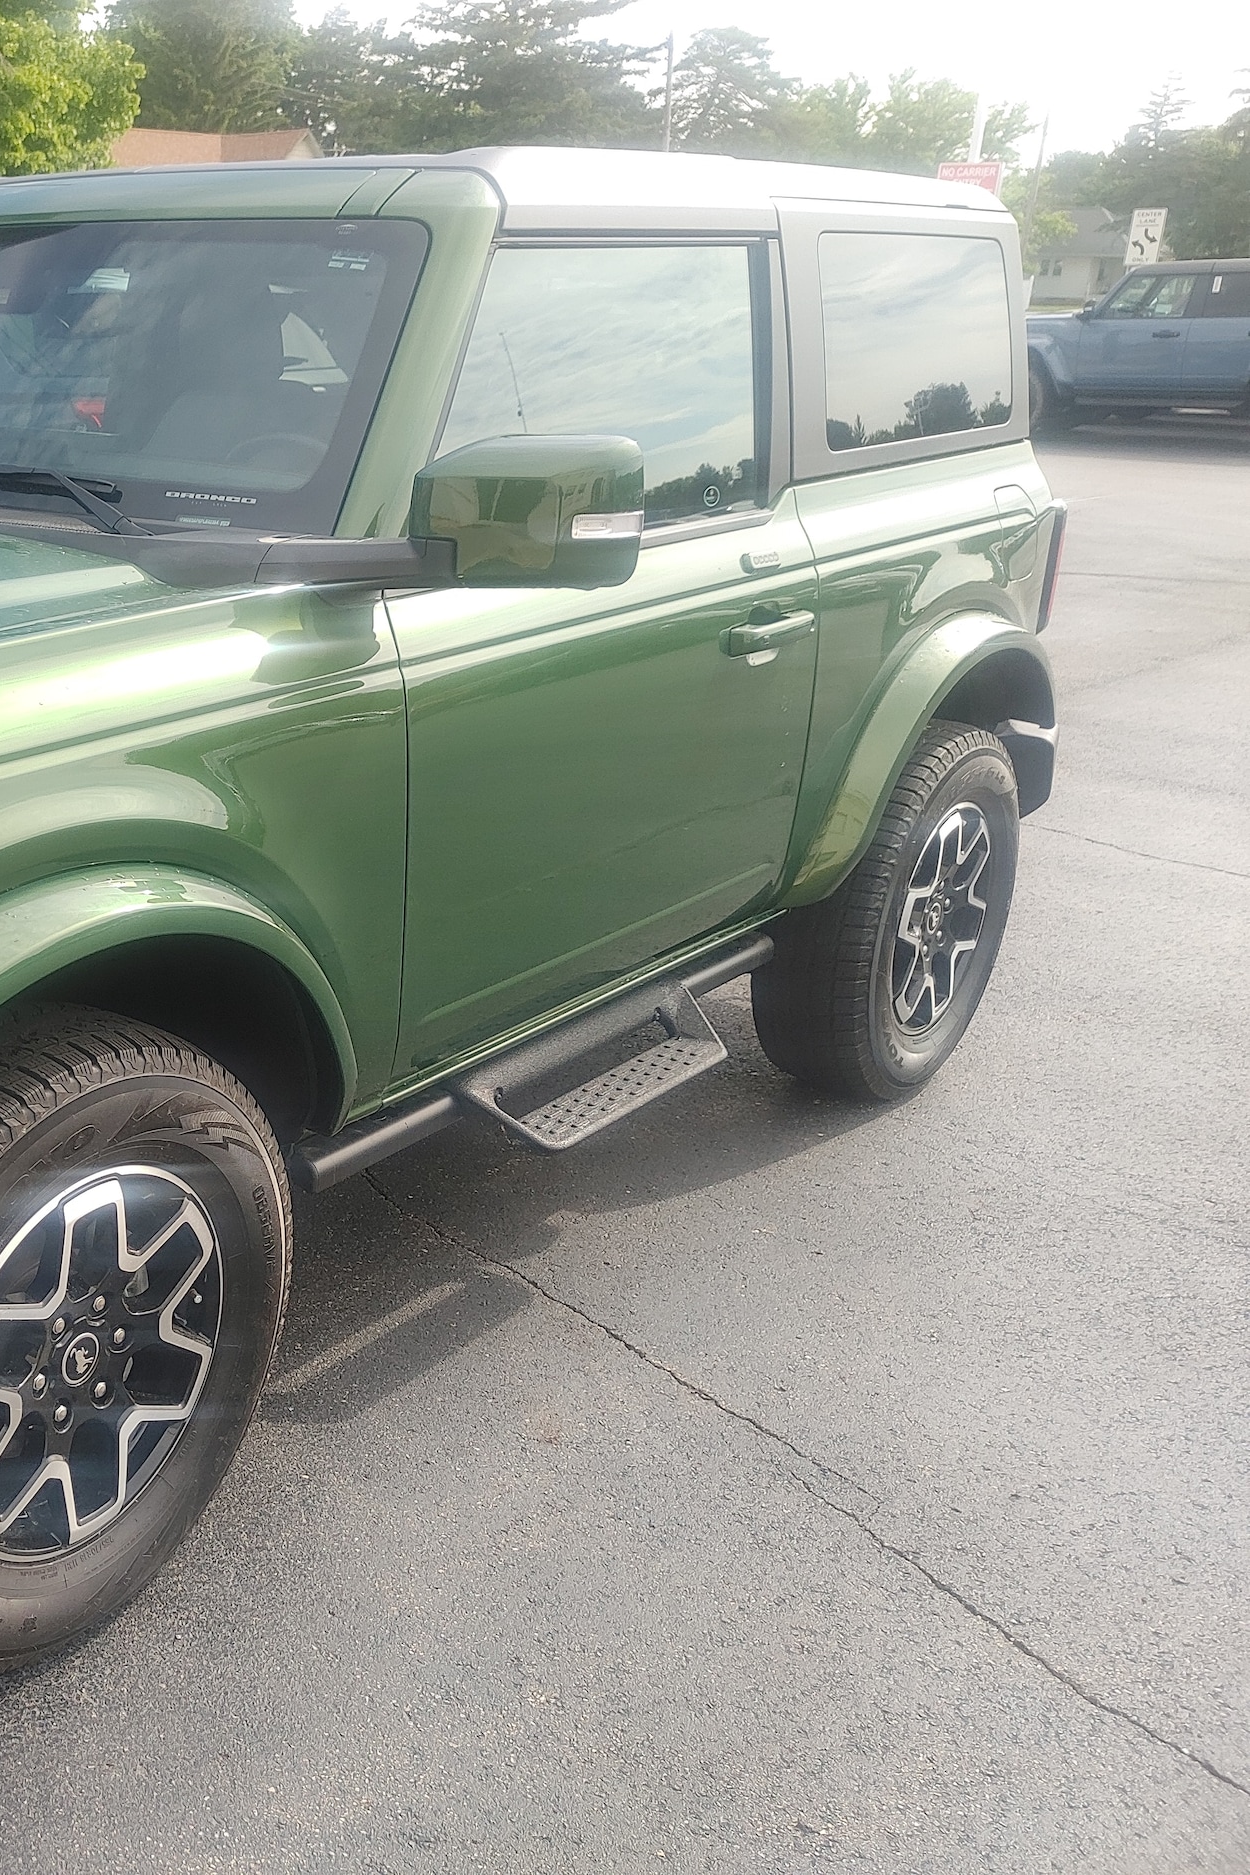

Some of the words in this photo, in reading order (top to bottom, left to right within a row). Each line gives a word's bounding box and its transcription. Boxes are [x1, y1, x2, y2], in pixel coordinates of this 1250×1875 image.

[941, 166, 955, 177] NO
[956, 166, 996, 177] CARRIER
[165, 491, 257, 505] BRONCO
